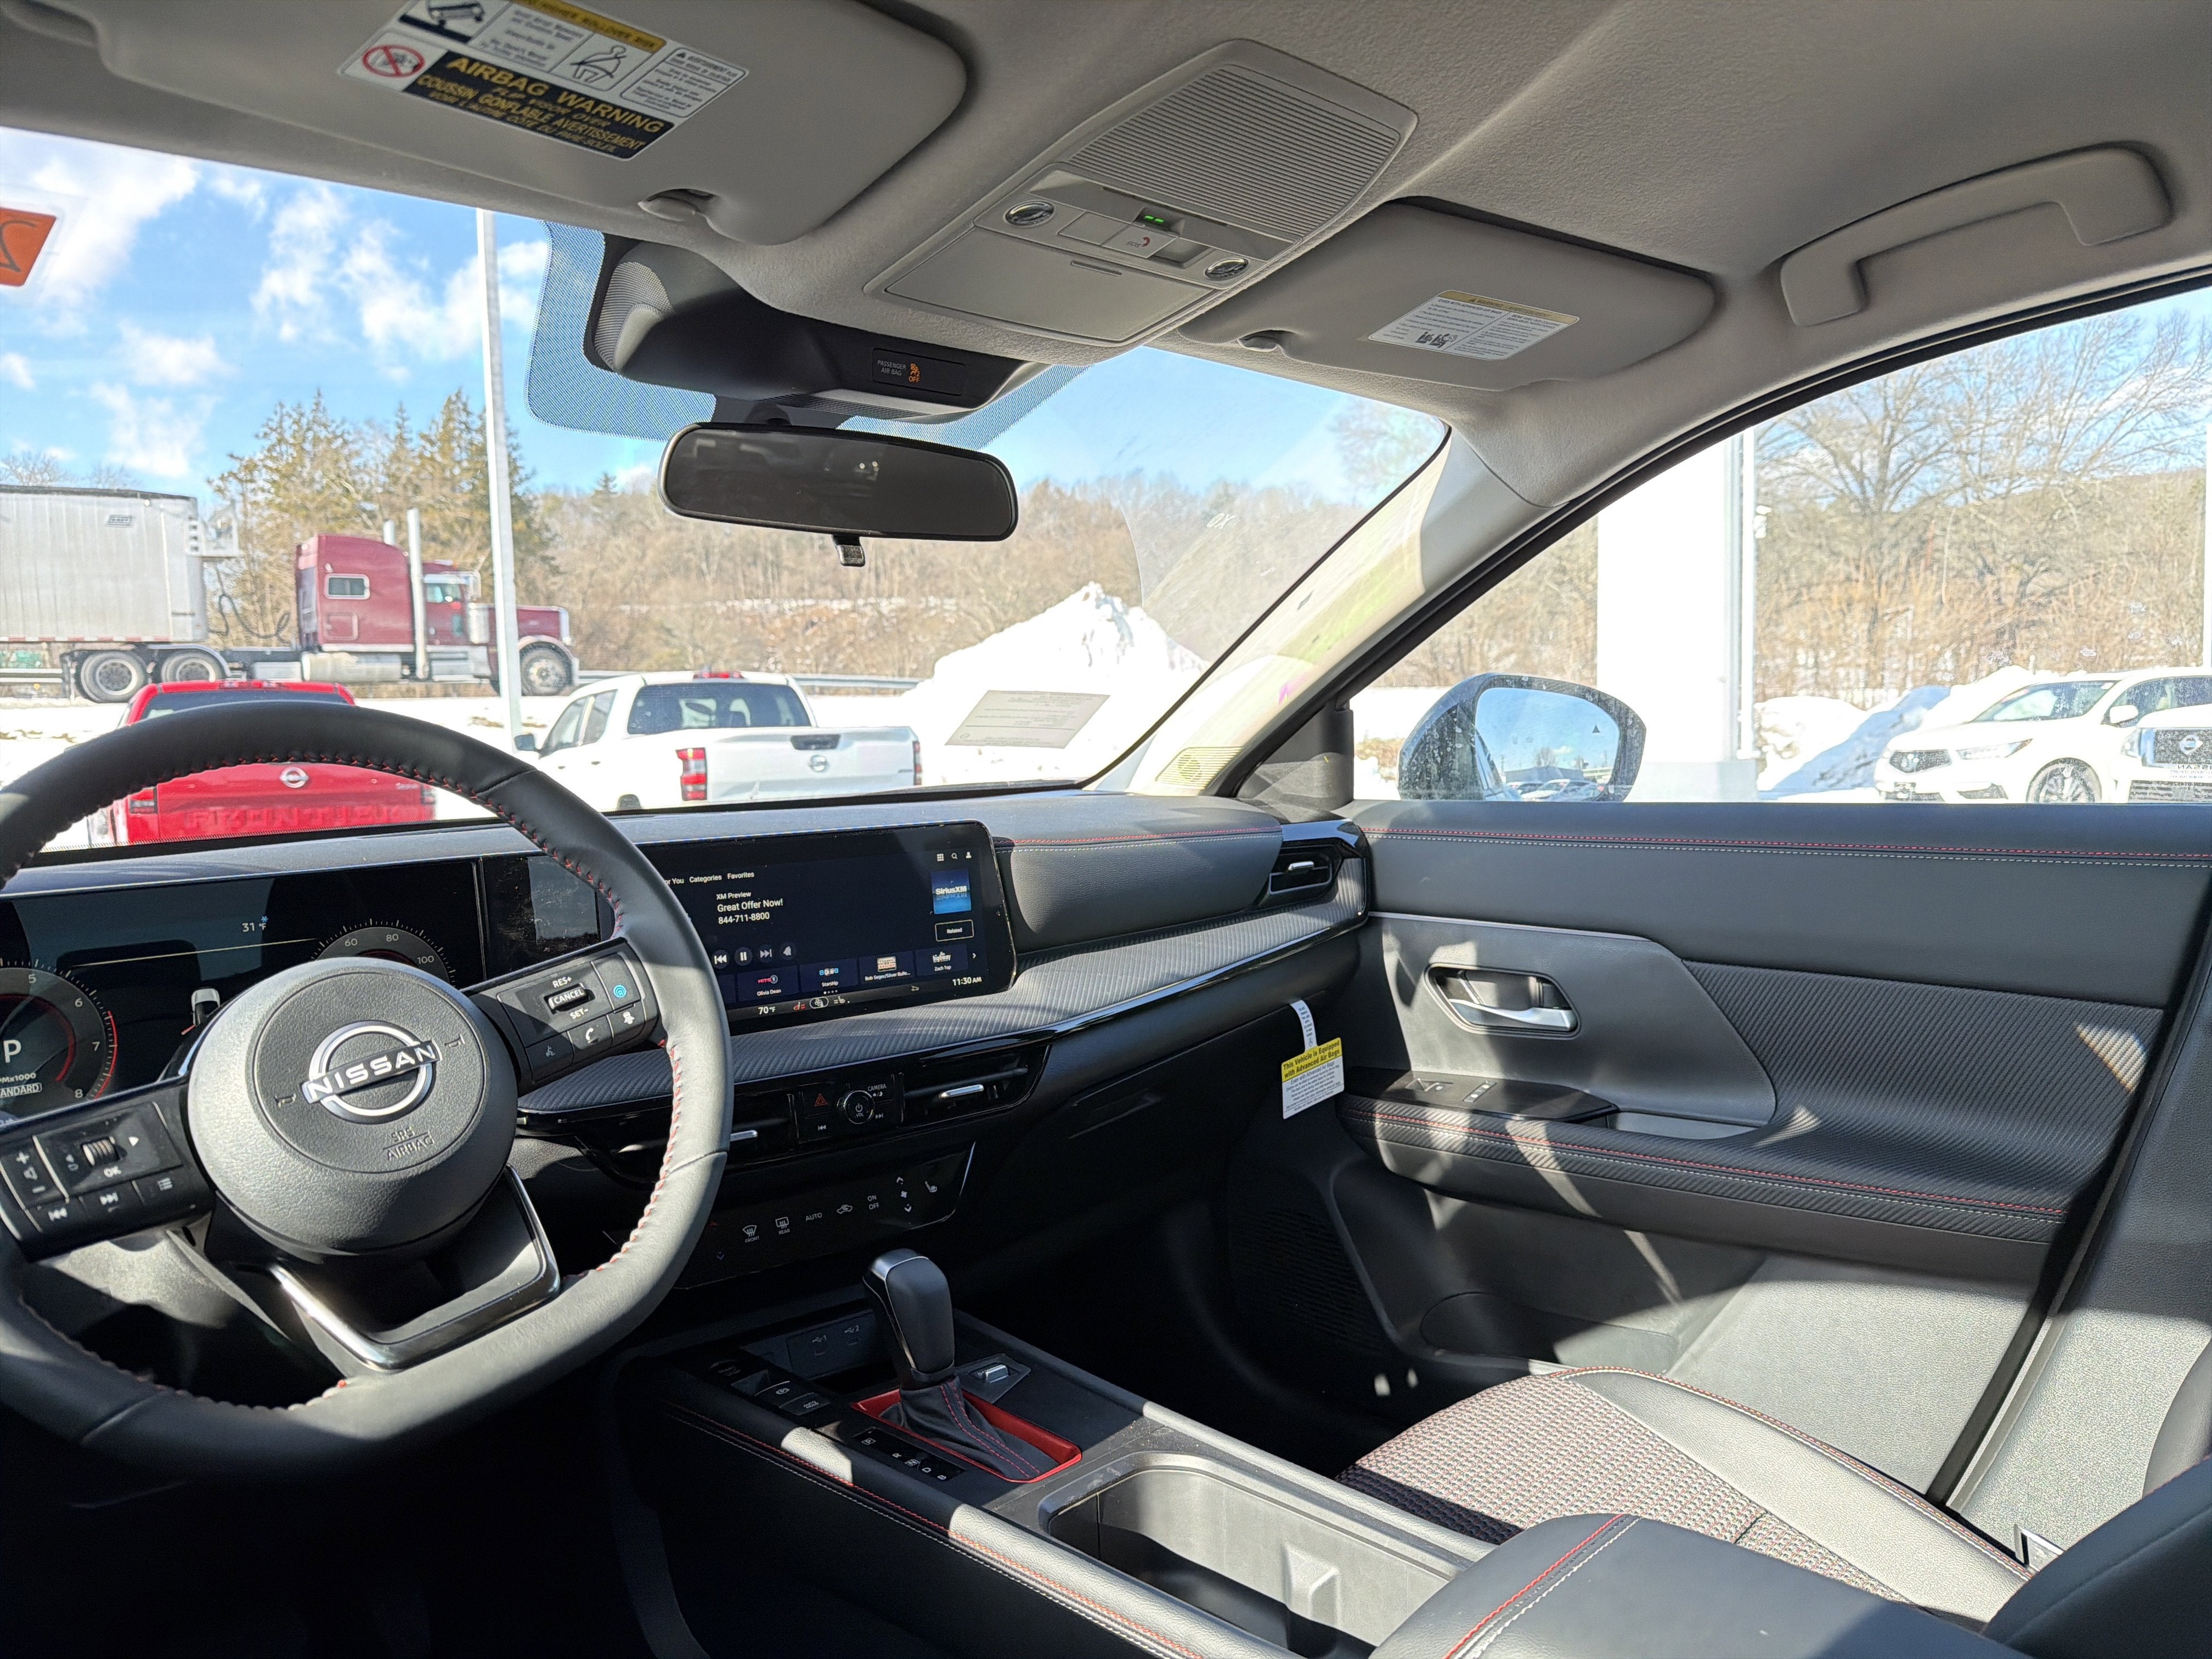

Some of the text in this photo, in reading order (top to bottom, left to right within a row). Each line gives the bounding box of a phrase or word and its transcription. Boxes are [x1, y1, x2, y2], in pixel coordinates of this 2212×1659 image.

[446, 57, 549, 96] AIRBAG
[557, 91, 664, 133] WARNING
[552, 117, 647, 149] AVERTISSEMENT
[878, 360, 906, 370] PASSENGER
[689, 874, 722, 884] Categories
[727, 871, 754, 879] Favorites
[935, 885, 967, 895] SiriusXM
[717, 899, 783, 912] Great Offer Now!
[718, 912, 770, 924] 844-711-8800
[242, 922, 255, 932] 31
[345, 939, 357, 947] 60
[386, 934, 399, 942] 80
[417, 955, 434, 964] 100
[29, 974, 36, 983] 5
[552, 976, 572, 988] RES+
[952, 977, 972, 986] 11:30
[75, 998, 83, 1007] 6
[554, 989, 584, 1004] CANCEL
[570, 1007, 589, 1019] SET-
[3, 1040, 21, 1063] P
[92, 1042, 100, 1051] 7
[1295, 1053, 1312, 1064] Vehicle
[1318, 1040, 1340, 1054] Equipped
[1284, 1069, 1295, 1079] with
[1296, 1059, 1319, 1074] Advanced
[1328, 1049, 1340, 1059] Bags
[0, 1073, 36, 1084] Mx1000
[307, 1045, 436, 1100] NISSAN
[0, 1084, 39, 1097] ANDARD
[75, 1089, 83, 1098] 8
[391, 1126, 415, 1142] SRS
[387, 1134, 435, 1161] AIRBAG
[104, 1166, 122, 1177] OK
[805, 1212, 822, 1222] AUTO
